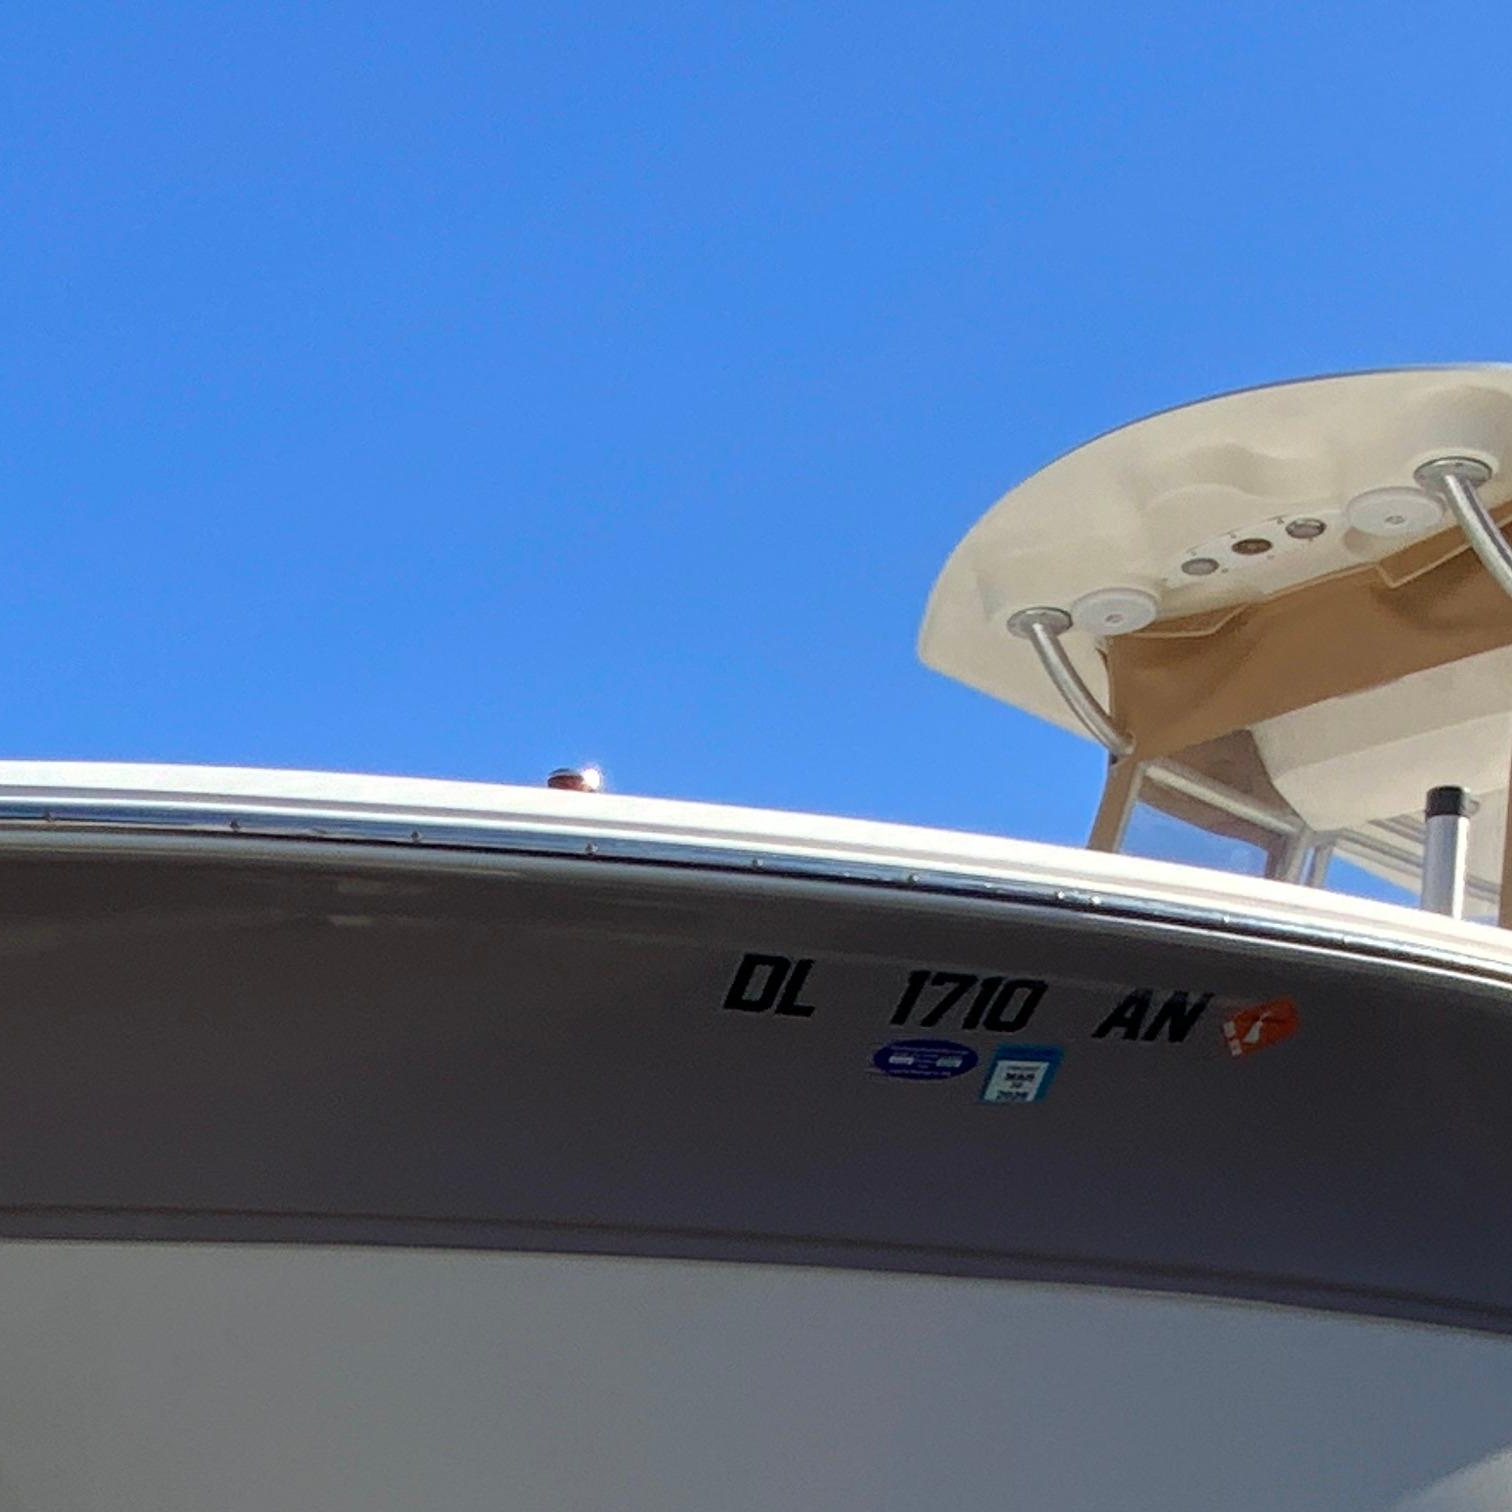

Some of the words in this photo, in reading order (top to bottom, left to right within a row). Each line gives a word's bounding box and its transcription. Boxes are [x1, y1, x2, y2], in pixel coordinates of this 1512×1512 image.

[722, 953, 816, 1017] DL
[890, 970, 1049, 1033] 1710
[1091, 988, 1215, 1042] AN
